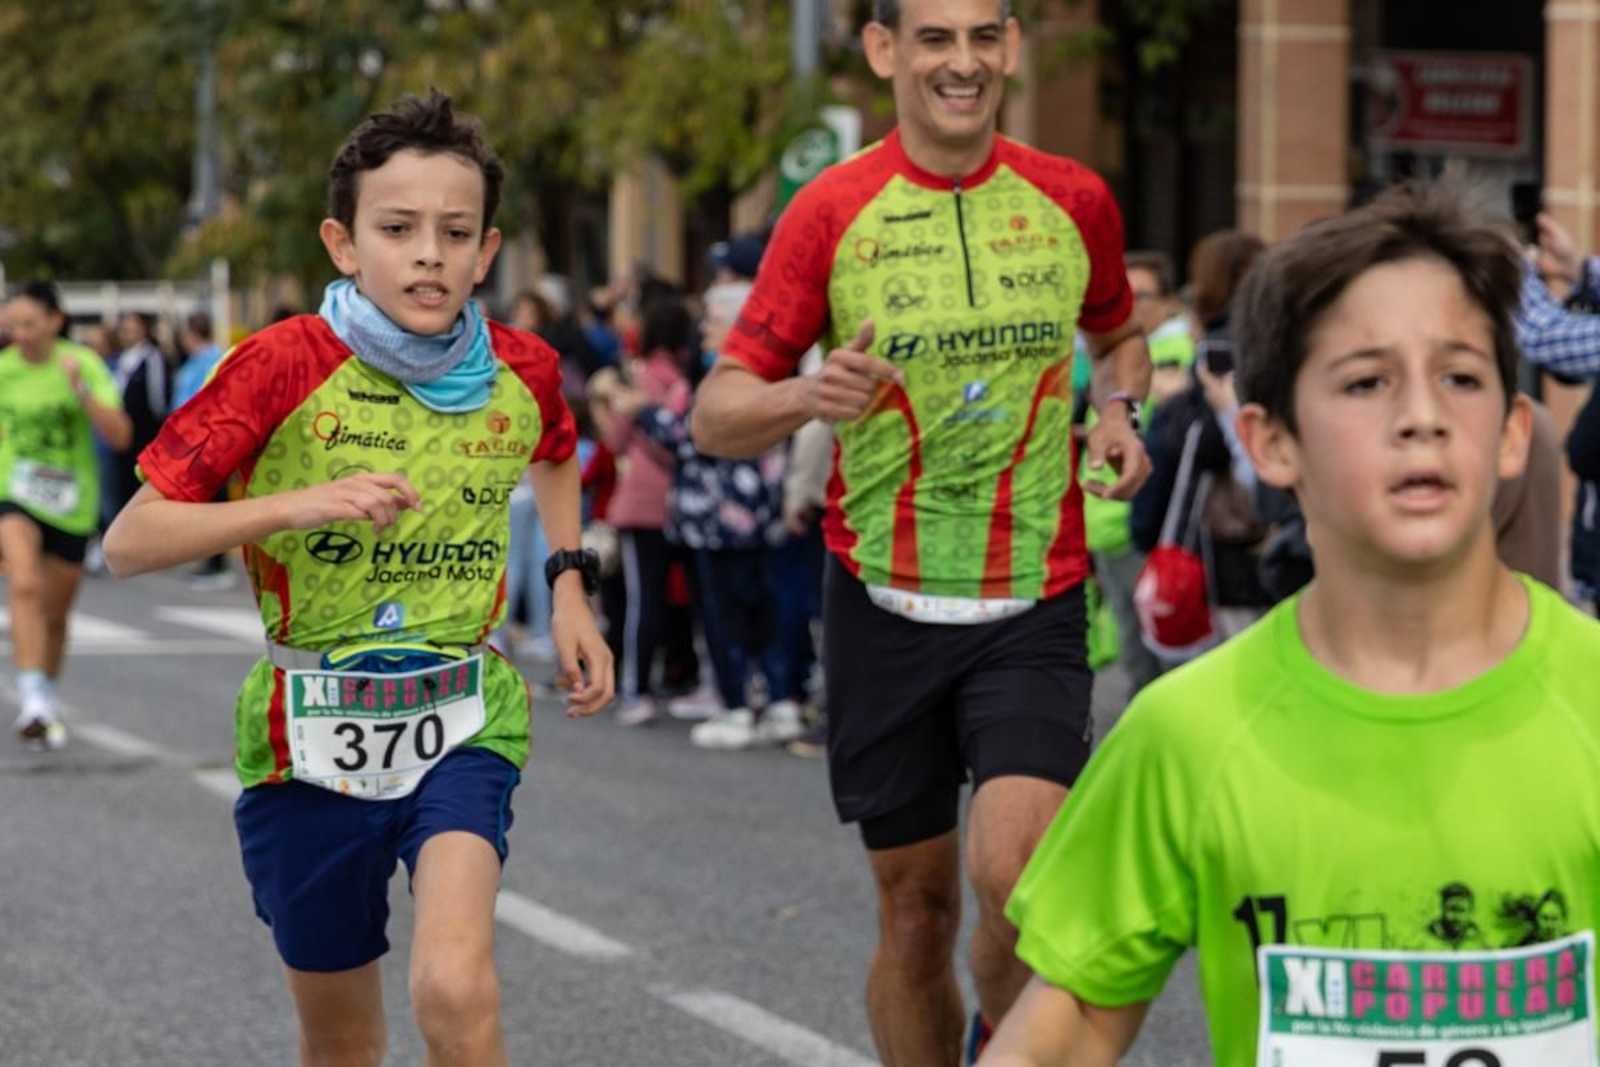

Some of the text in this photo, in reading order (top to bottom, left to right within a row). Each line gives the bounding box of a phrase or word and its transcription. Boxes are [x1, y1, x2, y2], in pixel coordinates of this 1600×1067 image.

[301, 675, 339, 708] XI
[341, 663, 469, 695] CARRRA
[333, 713, 444, 772] 370
[1281, 956, 1347, 1018] XI
[1352, 949, 1577, 991] CARRERA
[1352, 978, 1577, 1021] POPULAR
